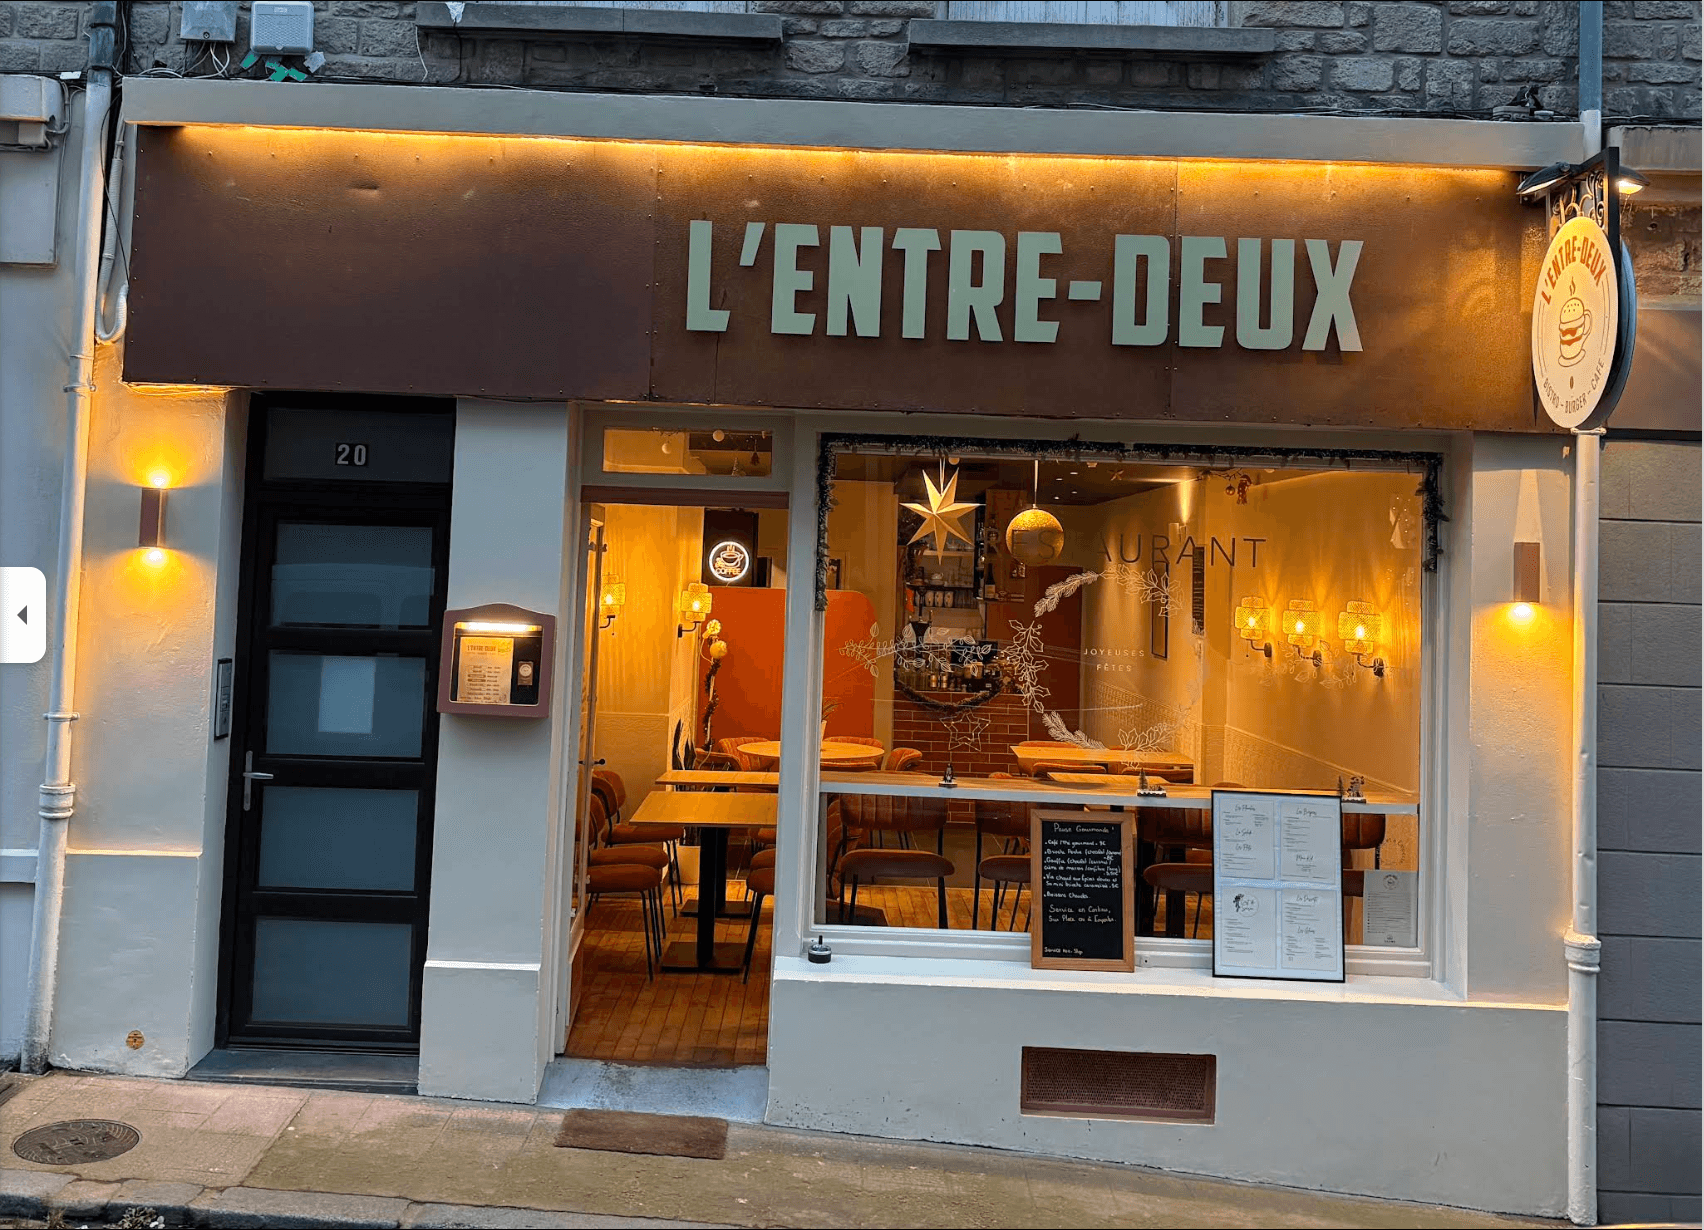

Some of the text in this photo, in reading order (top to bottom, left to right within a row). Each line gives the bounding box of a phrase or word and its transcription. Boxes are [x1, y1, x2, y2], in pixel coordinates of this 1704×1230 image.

[1541, 235, 1607, 305] L'ENTRE-DEUX
[686, 219, 1364, 352] L'ENTRE-DEUX
[1543, 377, 1560, 409] BISTRO
[1565, 392, 1587, 414] BURGER
[337, 443, 366, 466] 20
[984, 528, 1266, 567] RESAURANT
[1084, 648, 1145, 657] JOYEUSES
[1096, 664, 1132, 672] FÊTES
[1049, 904, 1075, 913] Service
[1061, 914, 1076, 922] Place
